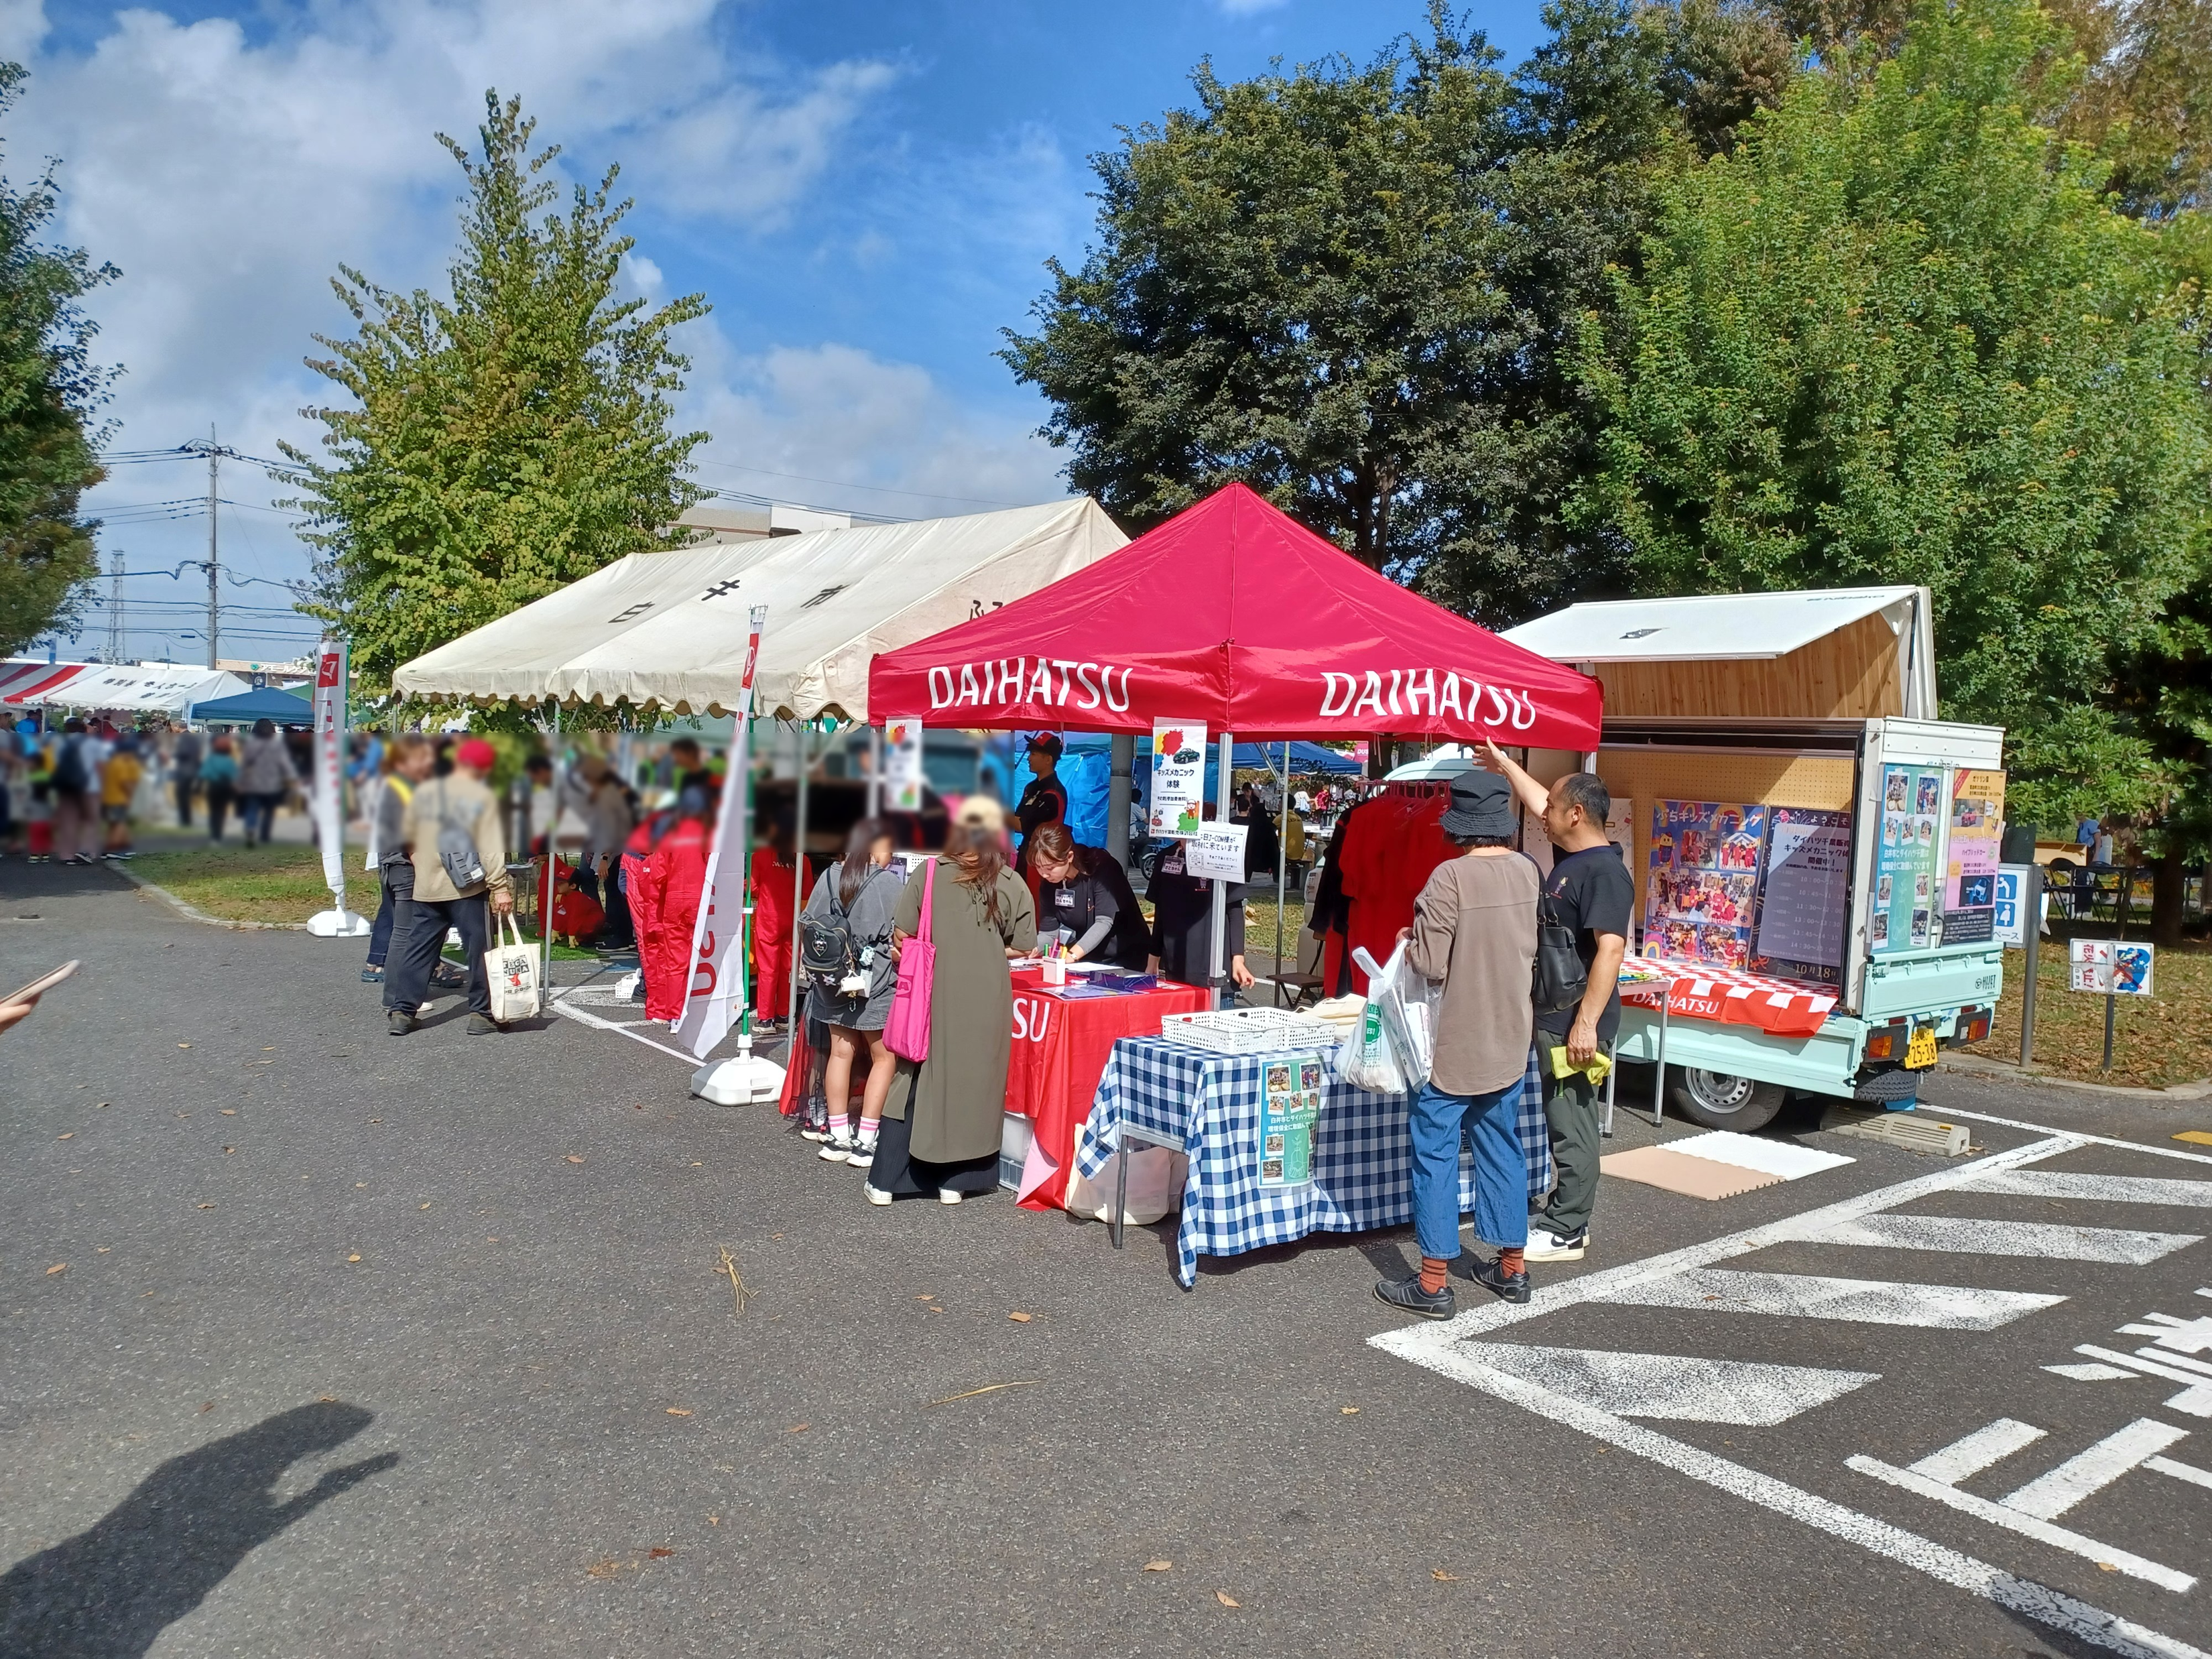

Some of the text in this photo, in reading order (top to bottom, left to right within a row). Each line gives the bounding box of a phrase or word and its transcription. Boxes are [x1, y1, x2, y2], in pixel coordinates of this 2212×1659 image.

[927, 657, 1133, 713] DAIHATSU
[1319, 668, 1536, 730] DAIHATSU
[1157, 768, 1194, 777] キッズメカニック
[1166, 780, 1180, 789] 体験
[1810, 814, 1849, 826] ようこそ
[1191, 839, 1240, 853] 取材に来ています
